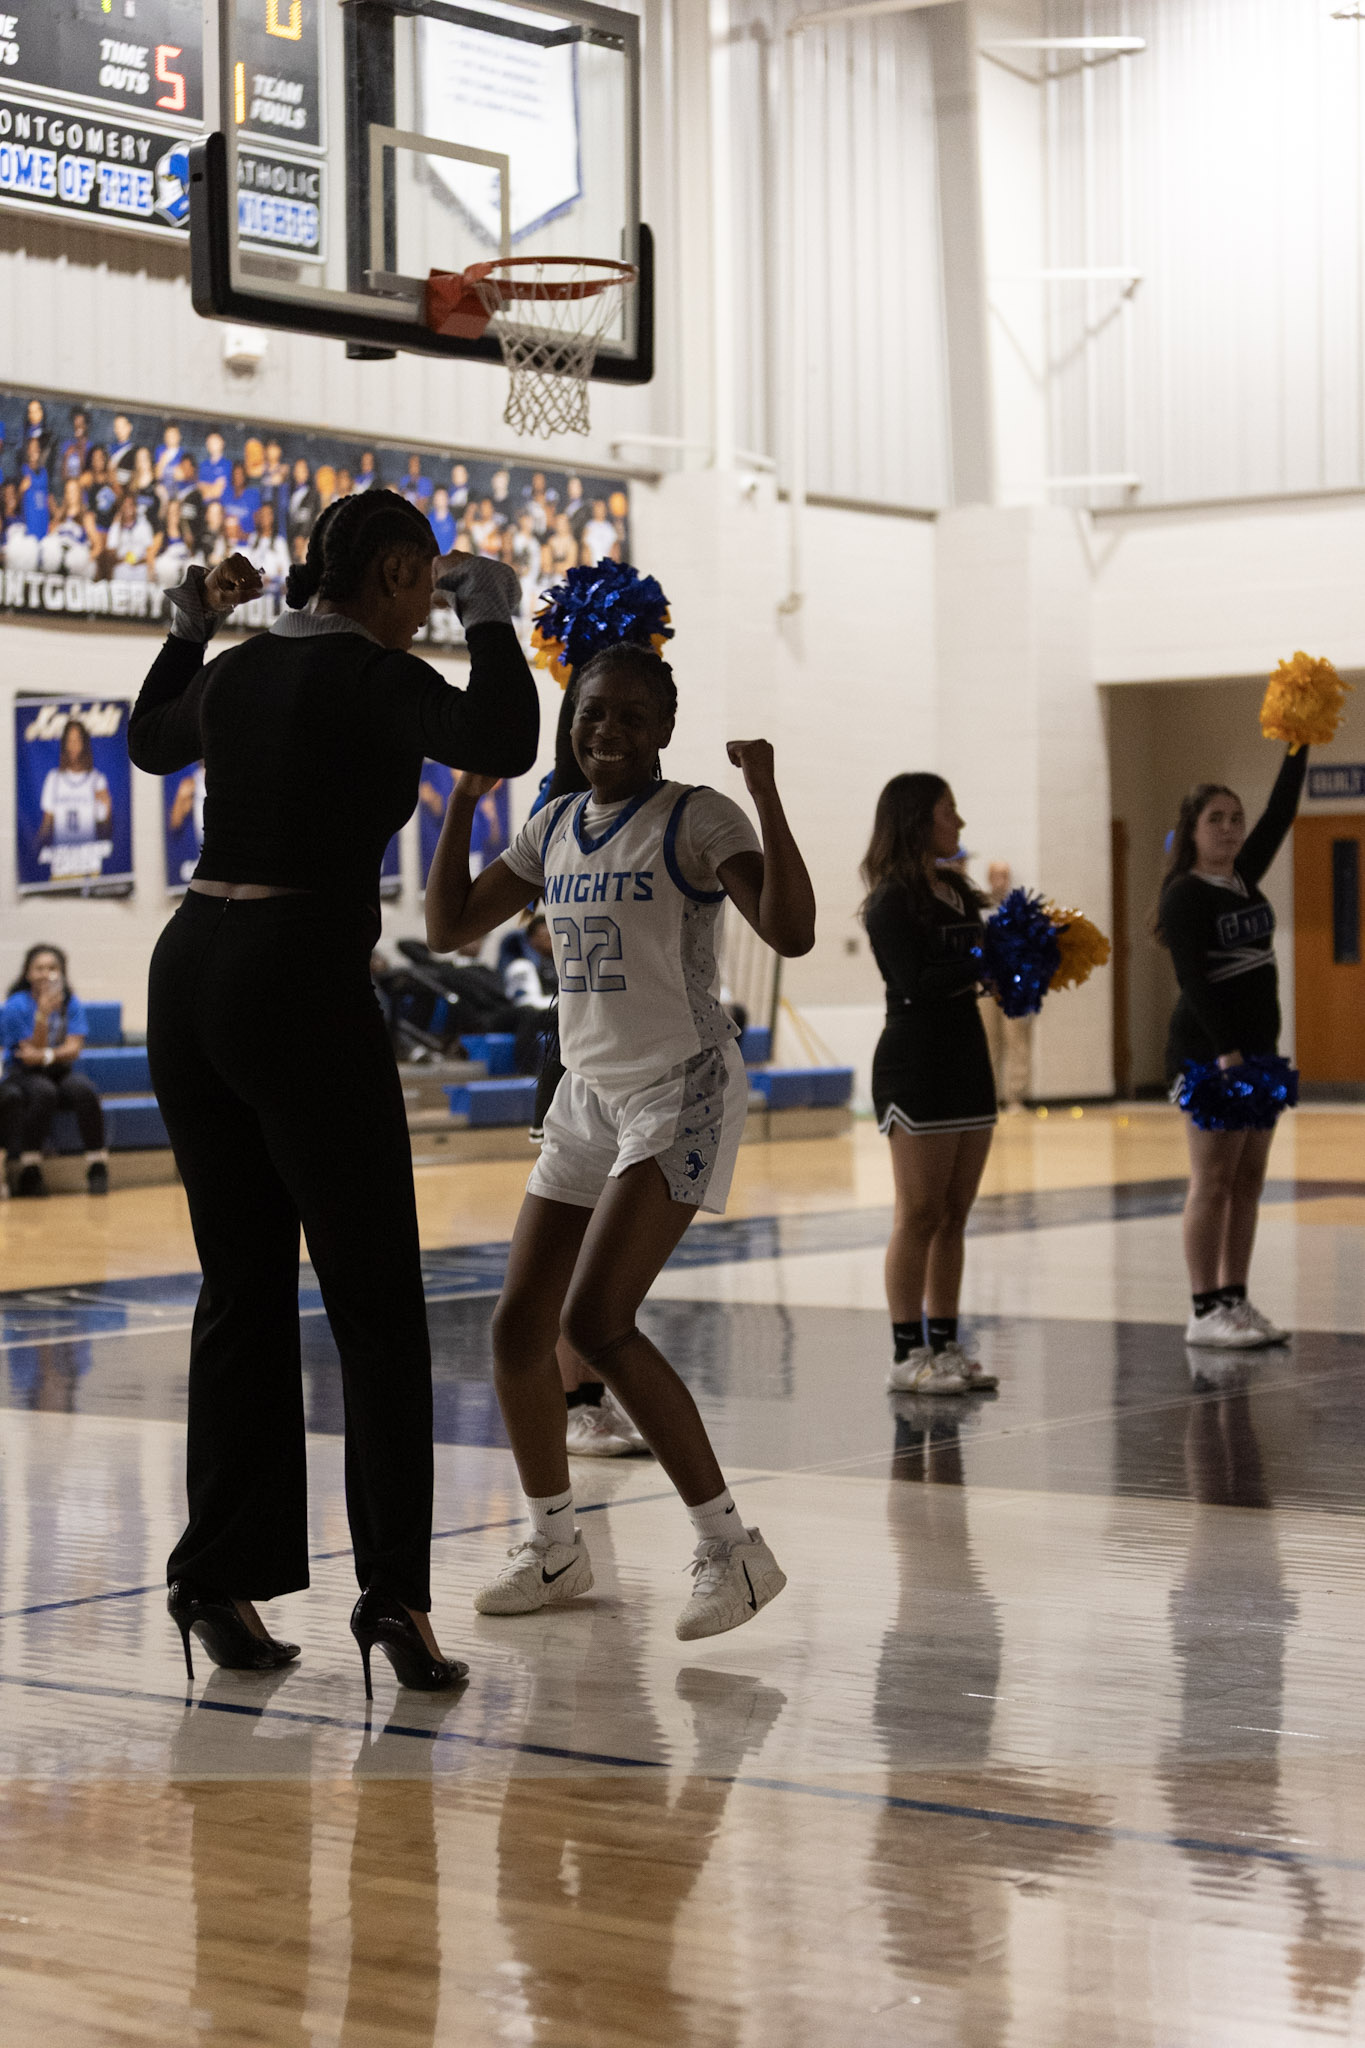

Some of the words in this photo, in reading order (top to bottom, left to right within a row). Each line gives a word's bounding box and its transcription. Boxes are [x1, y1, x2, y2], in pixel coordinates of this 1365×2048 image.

[100, 38, 149, 69] TIME
[99, 64, 150, 94] OUTS
[155, 45, 186, 111] 5
[253, 74, 304, 104] TEAM
[0, 108, 151, 164] ONTGOMERY
[249, 98, 307, 130] FOULS
[0, 141, 57, 198] OME
[58, 153, 96, 204] OF
[96, 160, 154, 217] THE
[237, 158, 320, 199] ATHOLIC
[0, 569, 166, 618] NTGOMERY
[553, 916, 627, 992] 22
